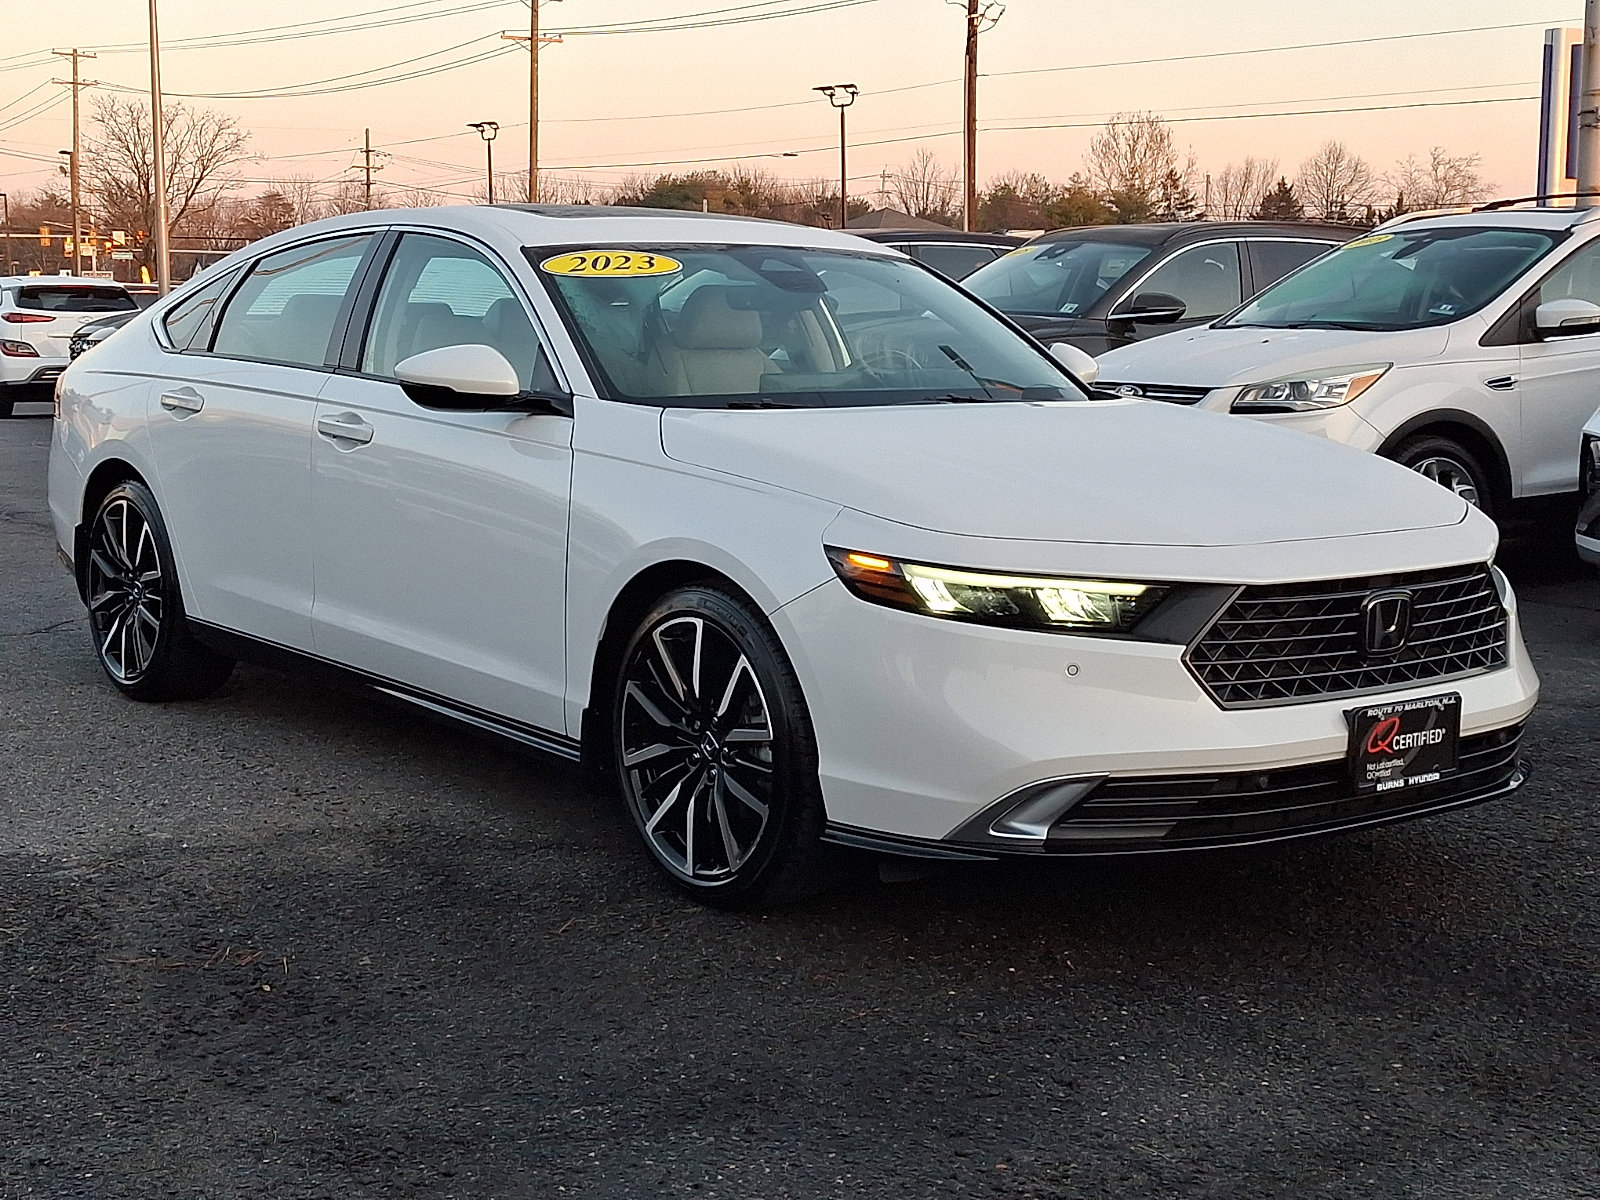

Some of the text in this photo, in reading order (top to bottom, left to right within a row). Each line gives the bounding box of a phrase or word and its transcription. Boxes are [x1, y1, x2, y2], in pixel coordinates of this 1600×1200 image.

[568, 255, 656, 272] 2023
[1367, 706, 1393, 717] ROUTE
[1393, 728, 1442, 750] CERTIFIED
[1376, 779, 1405, 791] BURNS
